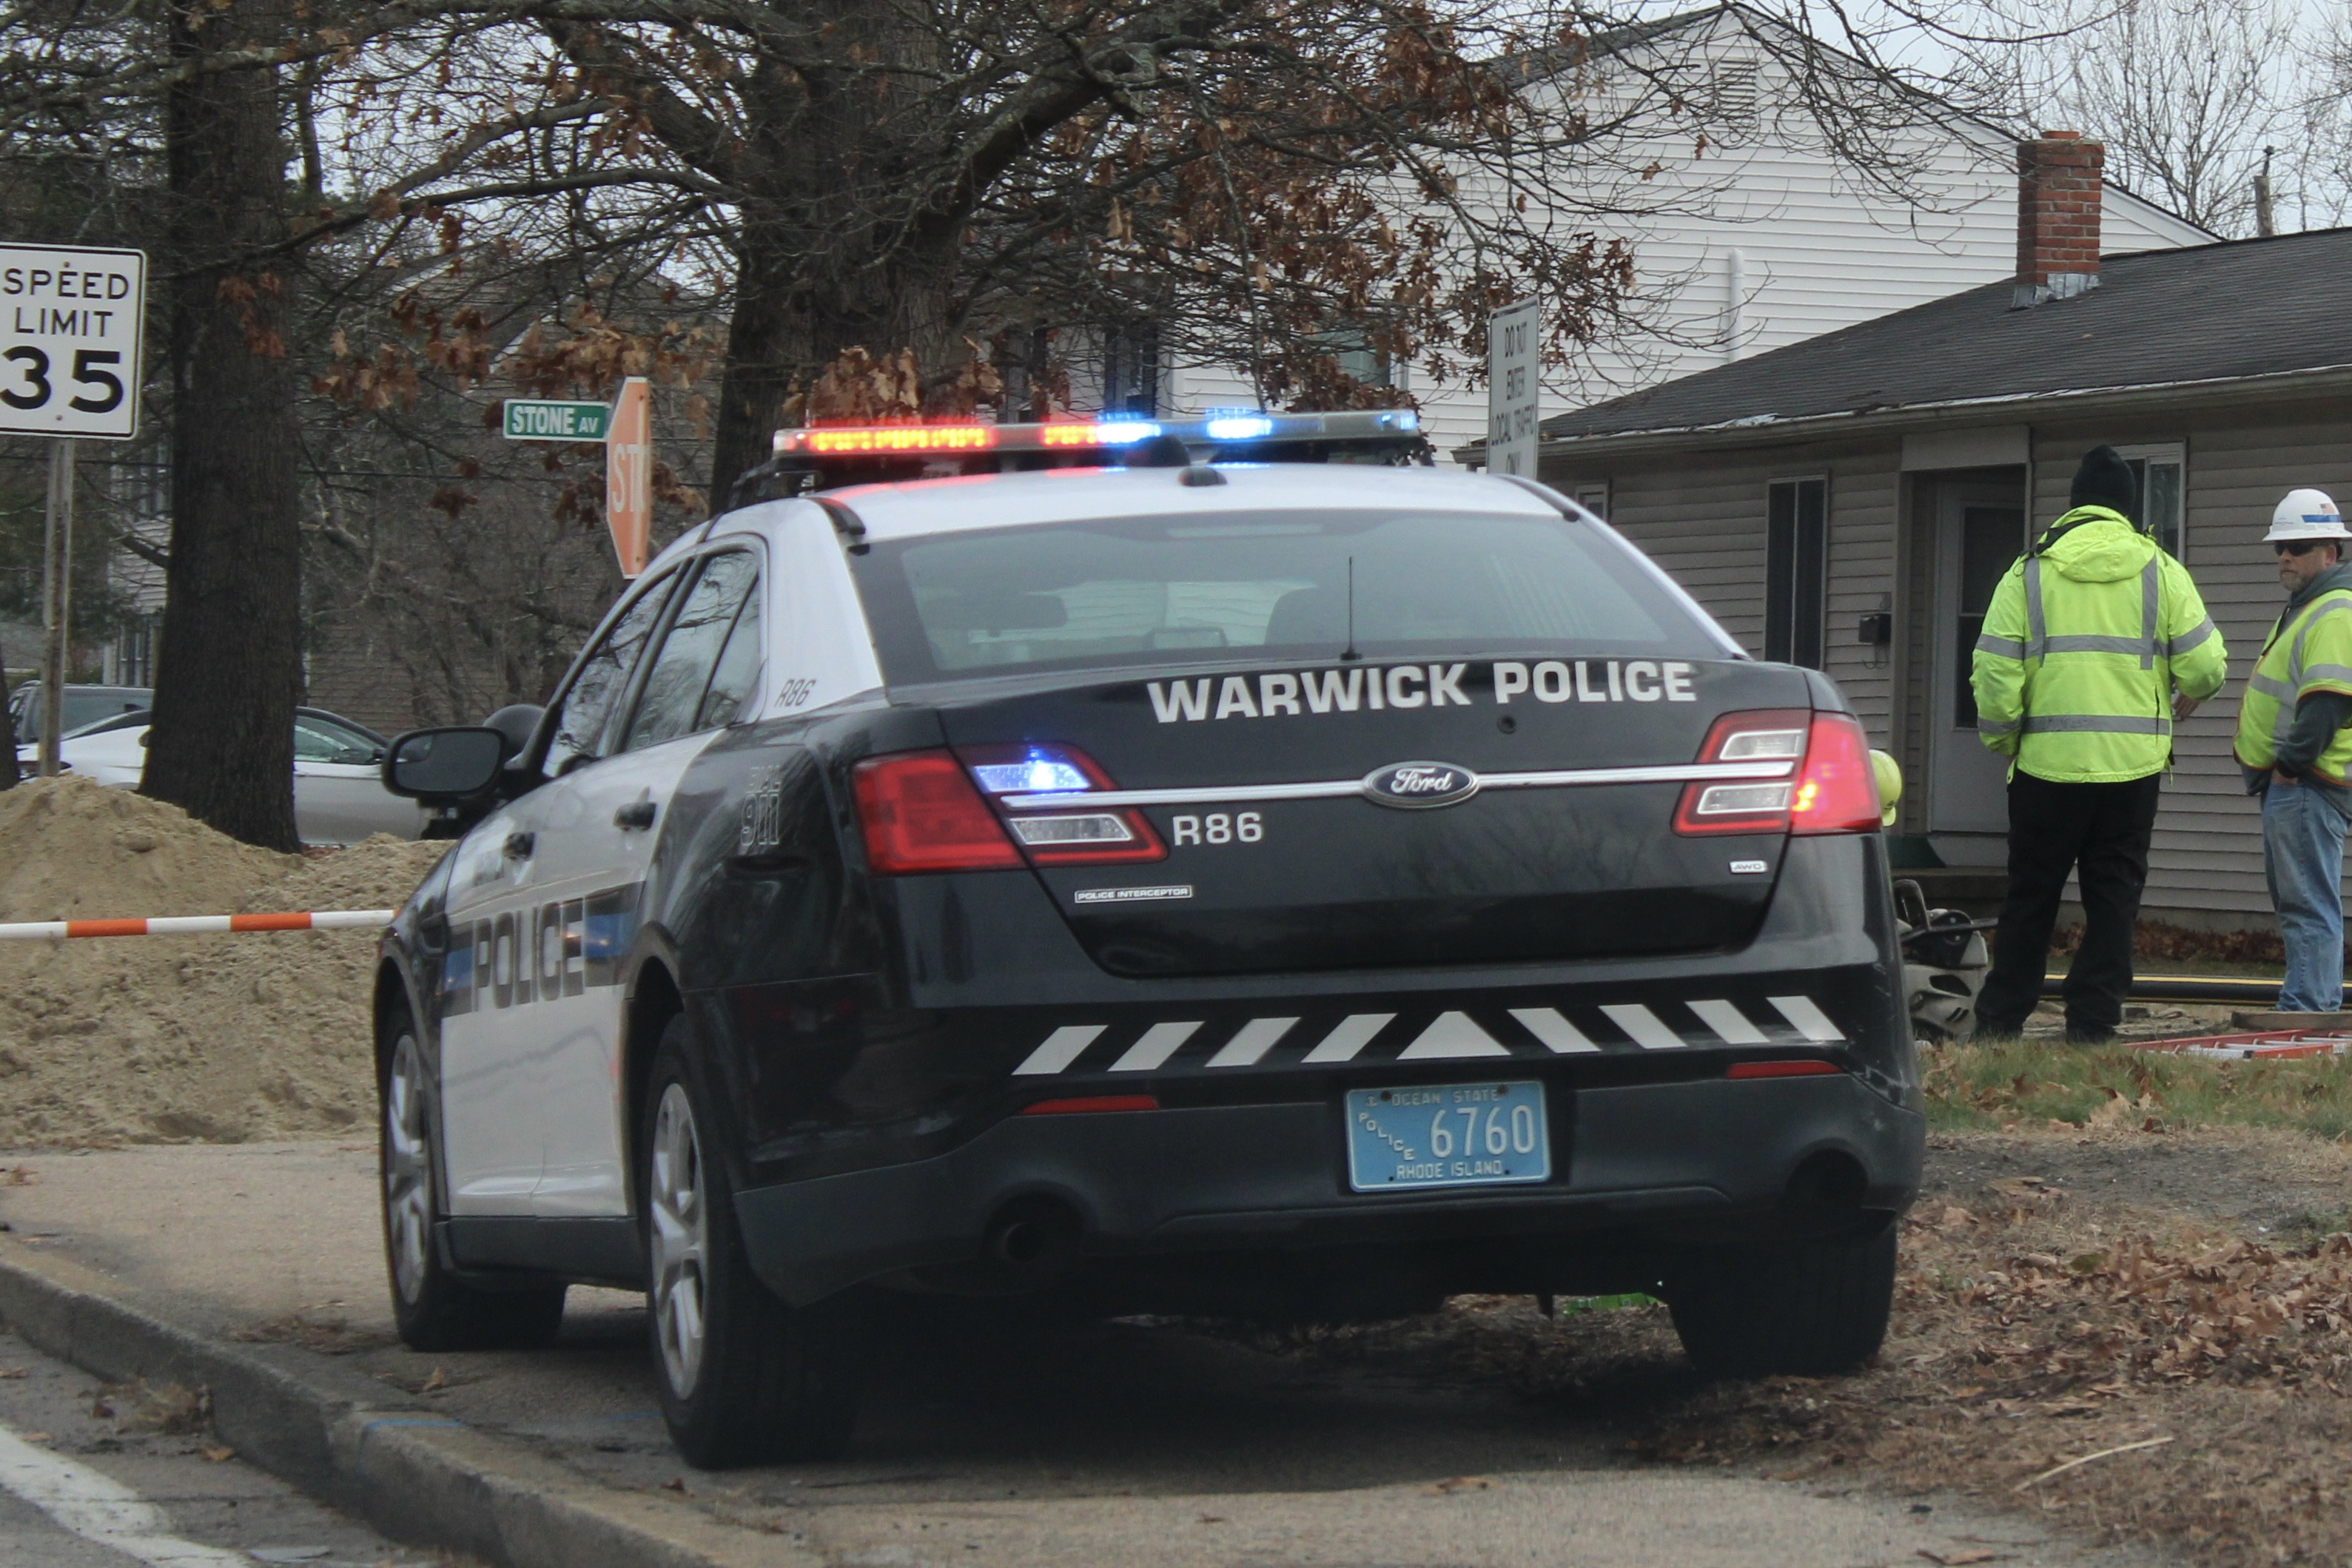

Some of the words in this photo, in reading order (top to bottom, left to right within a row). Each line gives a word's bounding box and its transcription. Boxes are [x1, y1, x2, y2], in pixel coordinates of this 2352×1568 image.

[3, 268, 129, 300] SPEED
[15, 307, 112, 337] LIMIT
[0, 346, 123, 413] 35
[512, 406, 575, 435] STONE
[578, 417, 599, 434] AV
[774, 679, 816, 707] R86
[1146, 663, 1472, 724] WARWICK
[1493, 661, 1698, 704] POLICE
[1391, 767, 1452, 793] Ford
[1172, 812, 1263, 847] R86
[1078, 891, 1115, 901] POLICE
[1117, 888, 1189, 898] INTERCEPTOR
[471, 897, 585, 1012] POLICE
[1391, 1093, 1441, 1106] OCEAN
[1452, 1089, 1501, 1103] STATE
[1358, 1112, 1416, 1162] POLICE
[1430, 1105, 1536, 1159] 6760
[1396, 1162, 1444, 1180] RHODE
[1451, 1160, 1502, 1177] ISLAND
